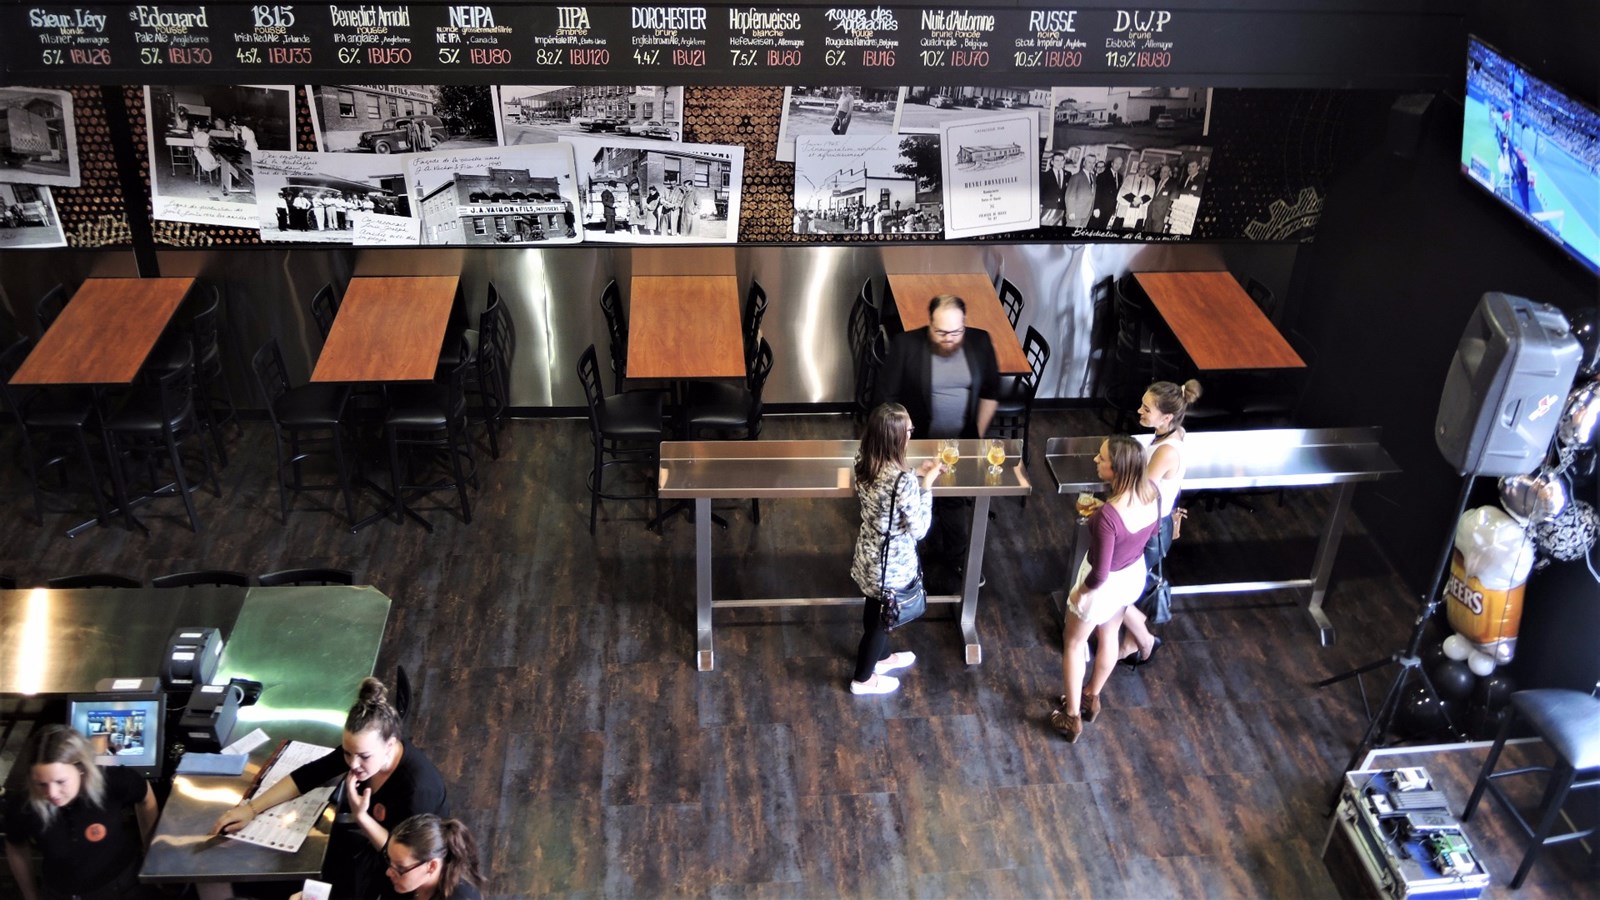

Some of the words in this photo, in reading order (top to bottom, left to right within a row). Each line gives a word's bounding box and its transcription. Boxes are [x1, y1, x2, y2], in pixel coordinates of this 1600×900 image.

[29, 8, 70, 28] Sieur
[74, 8, 107, 32] Léry
[136, 5, 209, 28] Edouard
[250, 4, 295, 28] 1815
[329, 4, 377, 27] Benedict
[378, 5, 411, 27] Arnold
[448, 6, 495, 29] NEIPA
[556, 7, 591, 29] IIPA
[631, 6, 707, 30] DORCHESTER
[729, 7, 801, 35] Hopfenweisse
[824, 8, 867, 23] Rouge
[870, 6, 893, 21] des
[921, 9, 946, 31] Nuit
[1029, 10, 1078, 33] RUSSE
[135, 31, 153, 43] Pale
[155, 27, 188, 35] rousse
[254, 27, 287, 35] rousse
[356, 26, 388, 34] rousse
[655, 29, 678, 37] brune
[752, 29, 784, 37] blanche
[42, 49, 65, 65] 5%
[70, 48, 112, 65] IBU26
[140, 48, 163, 65] 5%
[168, 48, 213, 65] IBU30
[268, 48, 313, 64] IBU35
[338, 46, 361, 64] 6%
[367, 47, 413, 65] IBU50
[438, 48, 460, 64] 5%
[470, 48, 512, 65] IBU80
[569, 48, 610, 65] IBU120
[633, 49, 661, 65] 4.4%
[672, 49, 706, 66] IBU21
[730, 49, 758, 66] 7.5%
[767, 49, 801, 66] IBU80
[825, 50, 846, 66] 6%
[862, 50, 896, 67] IBU16
[919, 50, 945, 66] 10%
[951, 51, 990, 67] IBU70
[1013, 50, 1042, 67] 10.5%
[1044, 51, 1083, 68] IBU80
[1105, 51, 1136, 68] 11.9%
[1137, 51, 1171, 68] IBU80
